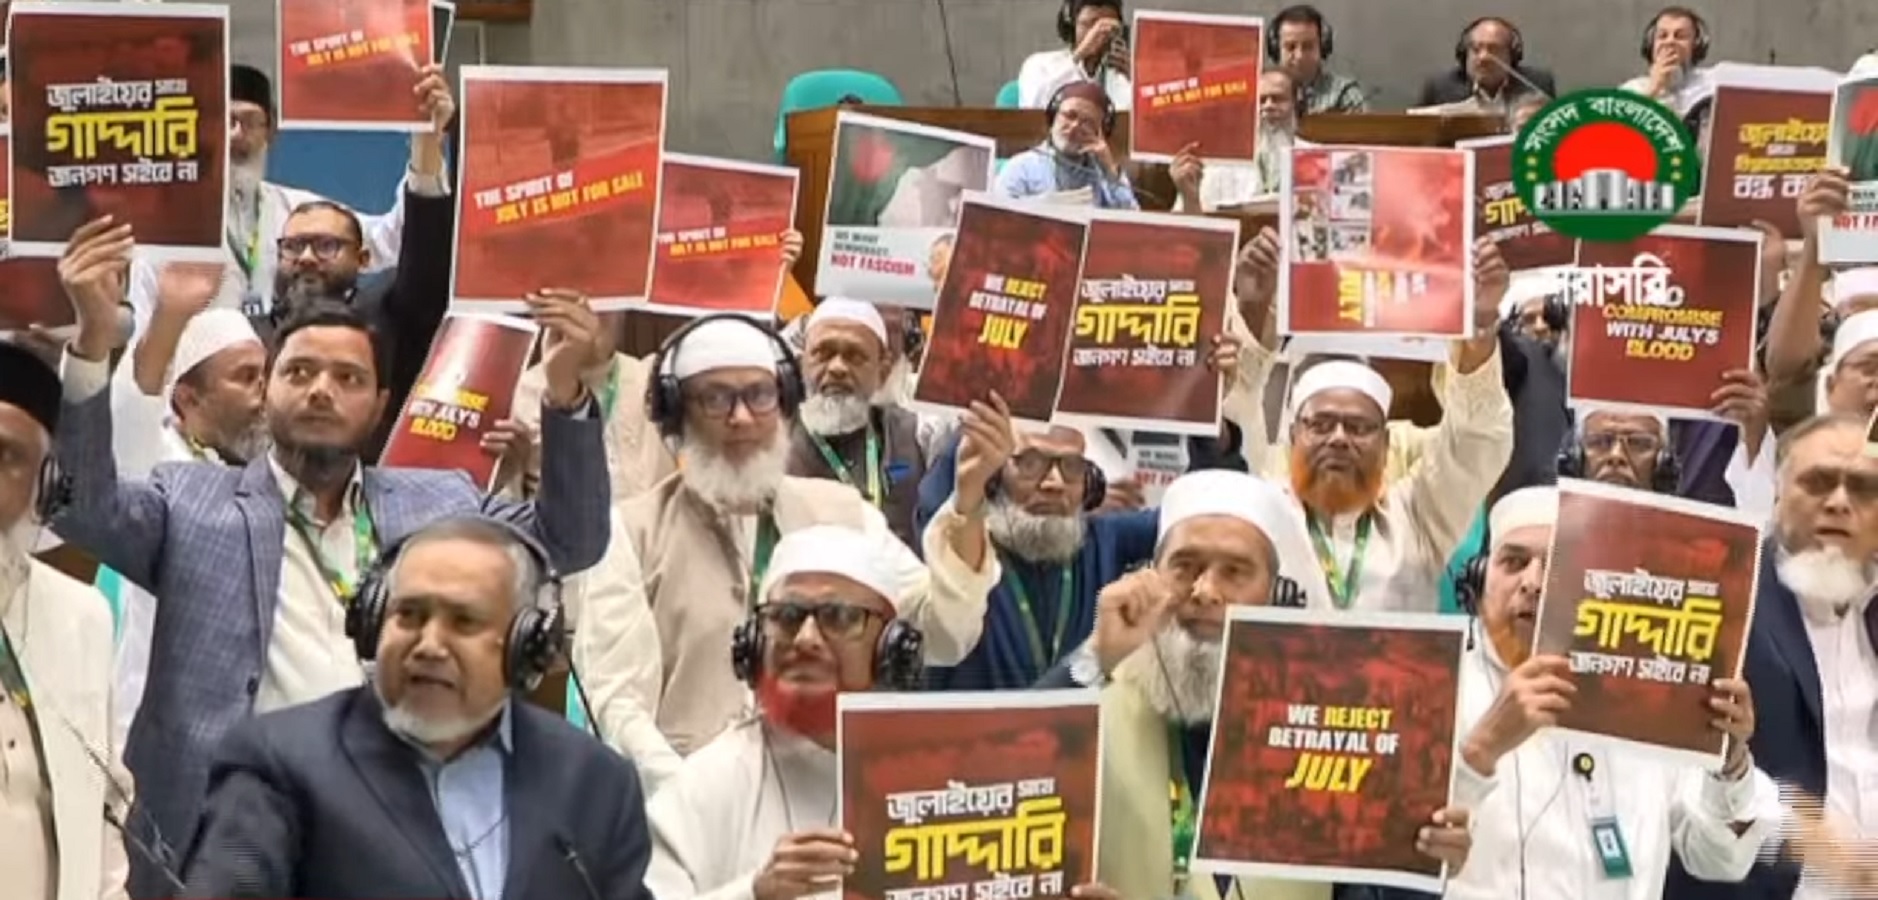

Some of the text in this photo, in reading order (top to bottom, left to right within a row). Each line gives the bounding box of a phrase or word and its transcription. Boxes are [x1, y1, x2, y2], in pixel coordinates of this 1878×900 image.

[46, 75, 152, 112] জুলাইয়ের
[46, 96, 198, 159] গাদ্দারি
[46, 157, 199, 187] জনগণ সইবে না
[831, 254, 915, 275] NOT FASCISM
[977, 313, 1028, 349] JULY
[1075, 295, 1201, 347] গাদ্দারি
[1601, 303, 1723, 327] COMPROMISE
[1606, 321, 1719, 345] WITH JULY'S
[1624, 339, 1696, 361] BLOOD
[1176, 348, 1196, 367] না
[1583, 566, 1686, 607] জুলাইয়ের
[1573, 597, 1723, 660] গাদ্দারি
[1569, 651, 1713, 685] জনগণ সইবে না
[1288, 704, 1392, 730] WE REJECT
[1268, 726, 1400, 755] BETRAYAL OF
[1285, 751, 1373, 793] JULY
[885, 779, 1013, 824] জুলাইয়ের
[885, 796, 1066, 880] গাদ্দারি
[1038, 870, 1064, 895] না
